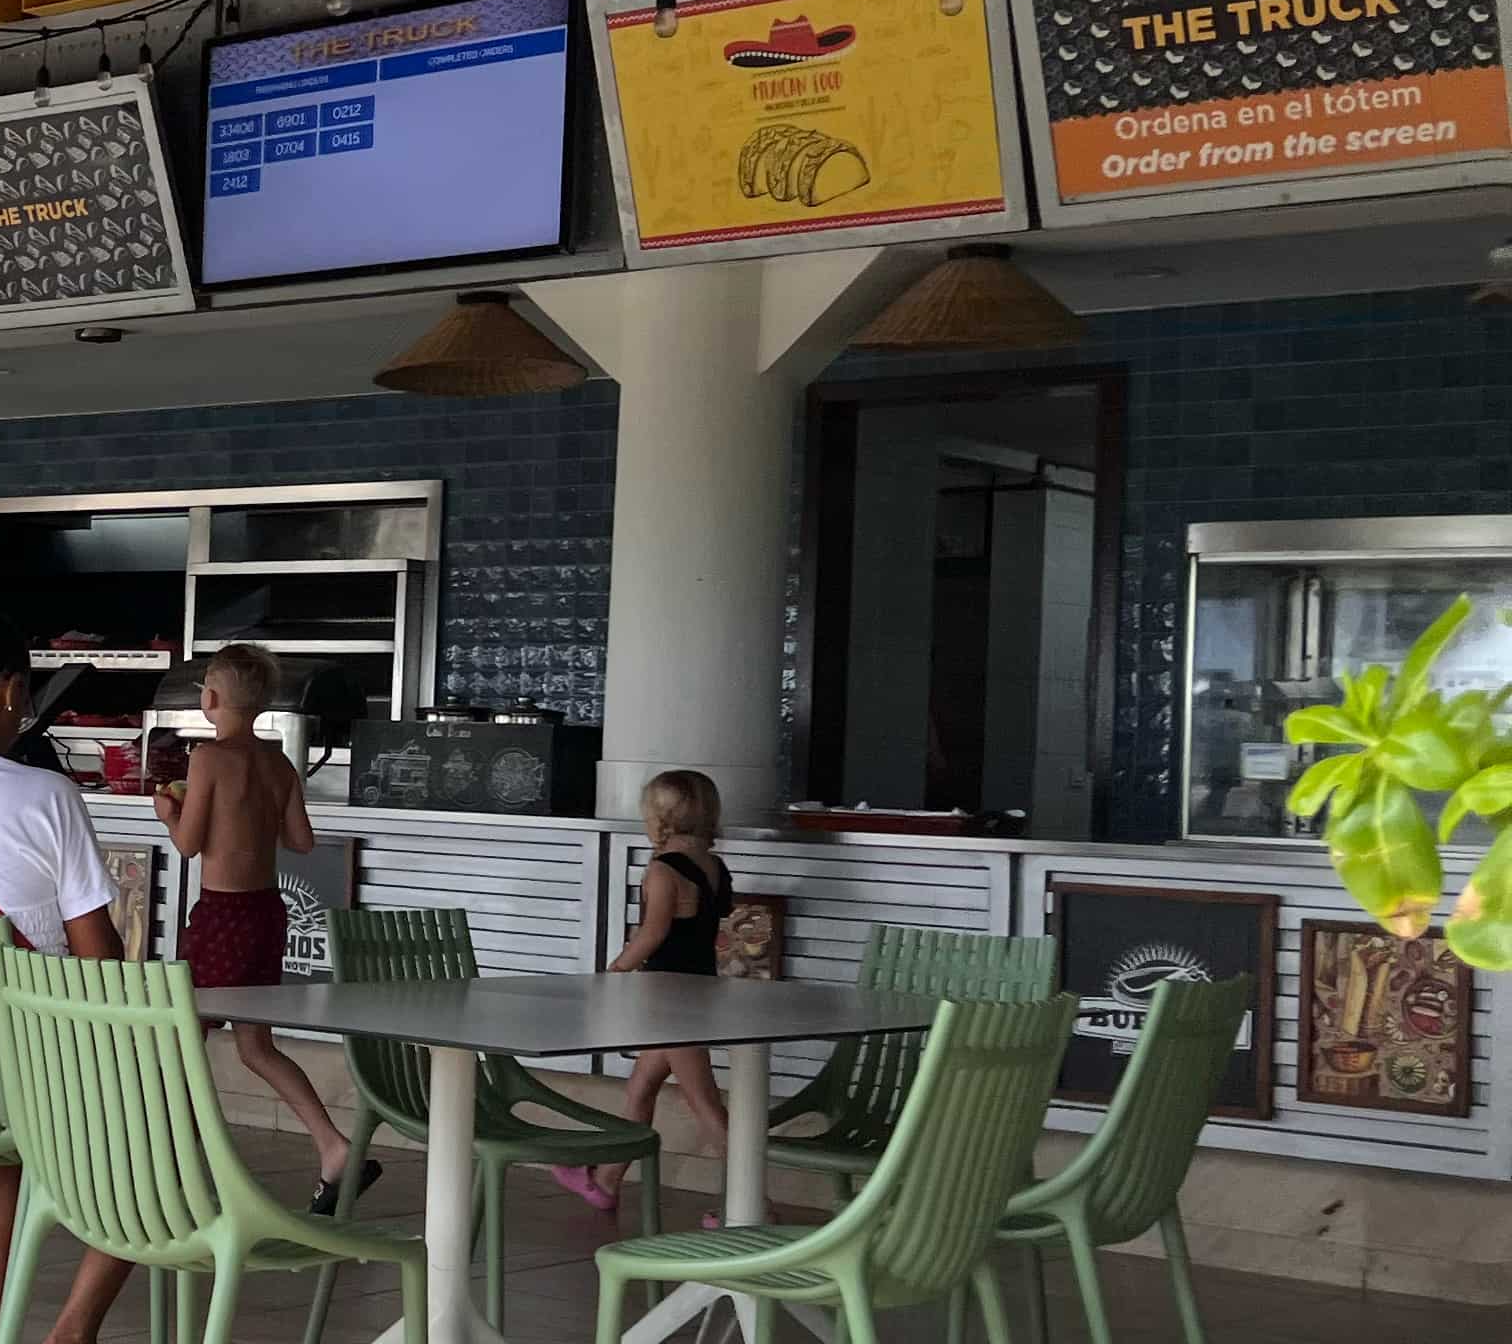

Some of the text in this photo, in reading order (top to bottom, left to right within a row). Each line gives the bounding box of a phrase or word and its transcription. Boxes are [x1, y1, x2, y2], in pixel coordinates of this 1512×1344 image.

[294, 16, 482, 61] THE TRUCK
[1122, 6, 1217, 50] THE
[1115, 84, 1422, 140] Ordena en el tótem
[1102, 120, 1457, 178] Order from the screen
[22, 197, 89, 223] TRUCK
